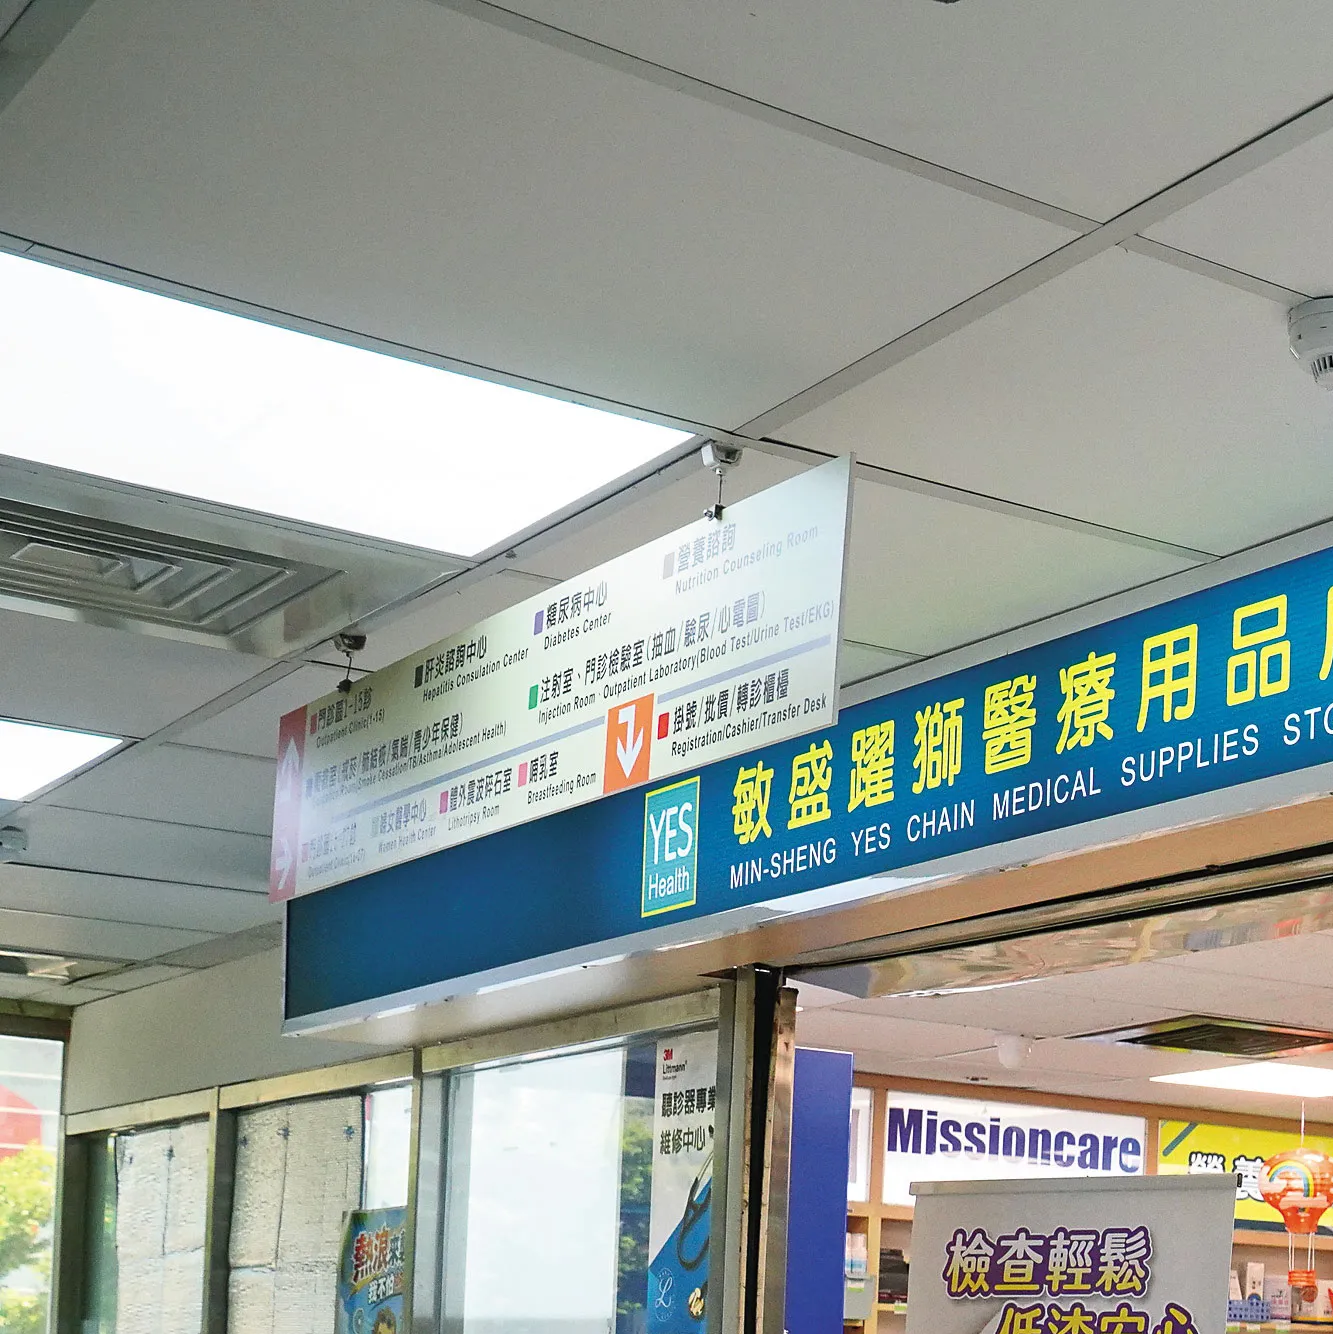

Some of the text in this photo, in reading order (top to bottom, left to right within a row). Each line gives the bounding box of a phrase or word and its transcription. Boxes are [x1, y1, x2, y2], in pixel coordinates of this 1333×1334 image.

[675, 525, 818, 594] Nutrition Counseling Room
[546, 581, 608, 629] 糖尿病中心
[544, 612, 612, 650] Diabetes Center
[423, 678, 454, 702] Hepatitis
[503, 647, 529, 668] Center
[424, 635, 487, 683] 肝炎諮詢中心
[538, 701, 571, 724] Injection
[730, 621, 779, 652] Test/Urine
[783, 600, 835, 631] Test/EKG)
[672, 694, 827, 757] Registration/Cashier/Transfer Desk
[527, 771, 597, 805] Breastfeeding Room
[730, 837, 836, 890] MIN-SHENG
[851, 822, 891, 857] YES
[906, 799, 975, 842] CHAIN
[993, 767, 1101, 821] MEDICAL
[1121, 724, 1259, 788] SUPPLIES
[448, 803, 500, 832] Lithotripsy Room
[649, 801, 693, 865] YES
[648, 866, 690, 901] Health
[661, 1060, 688, 1075] Littmann
[662, 1048, 674, 1062] 3M
[887, 1107, 1142, 1174] Missioncare
[948, 1229, 1150, 1296] 檢查輕鬆
